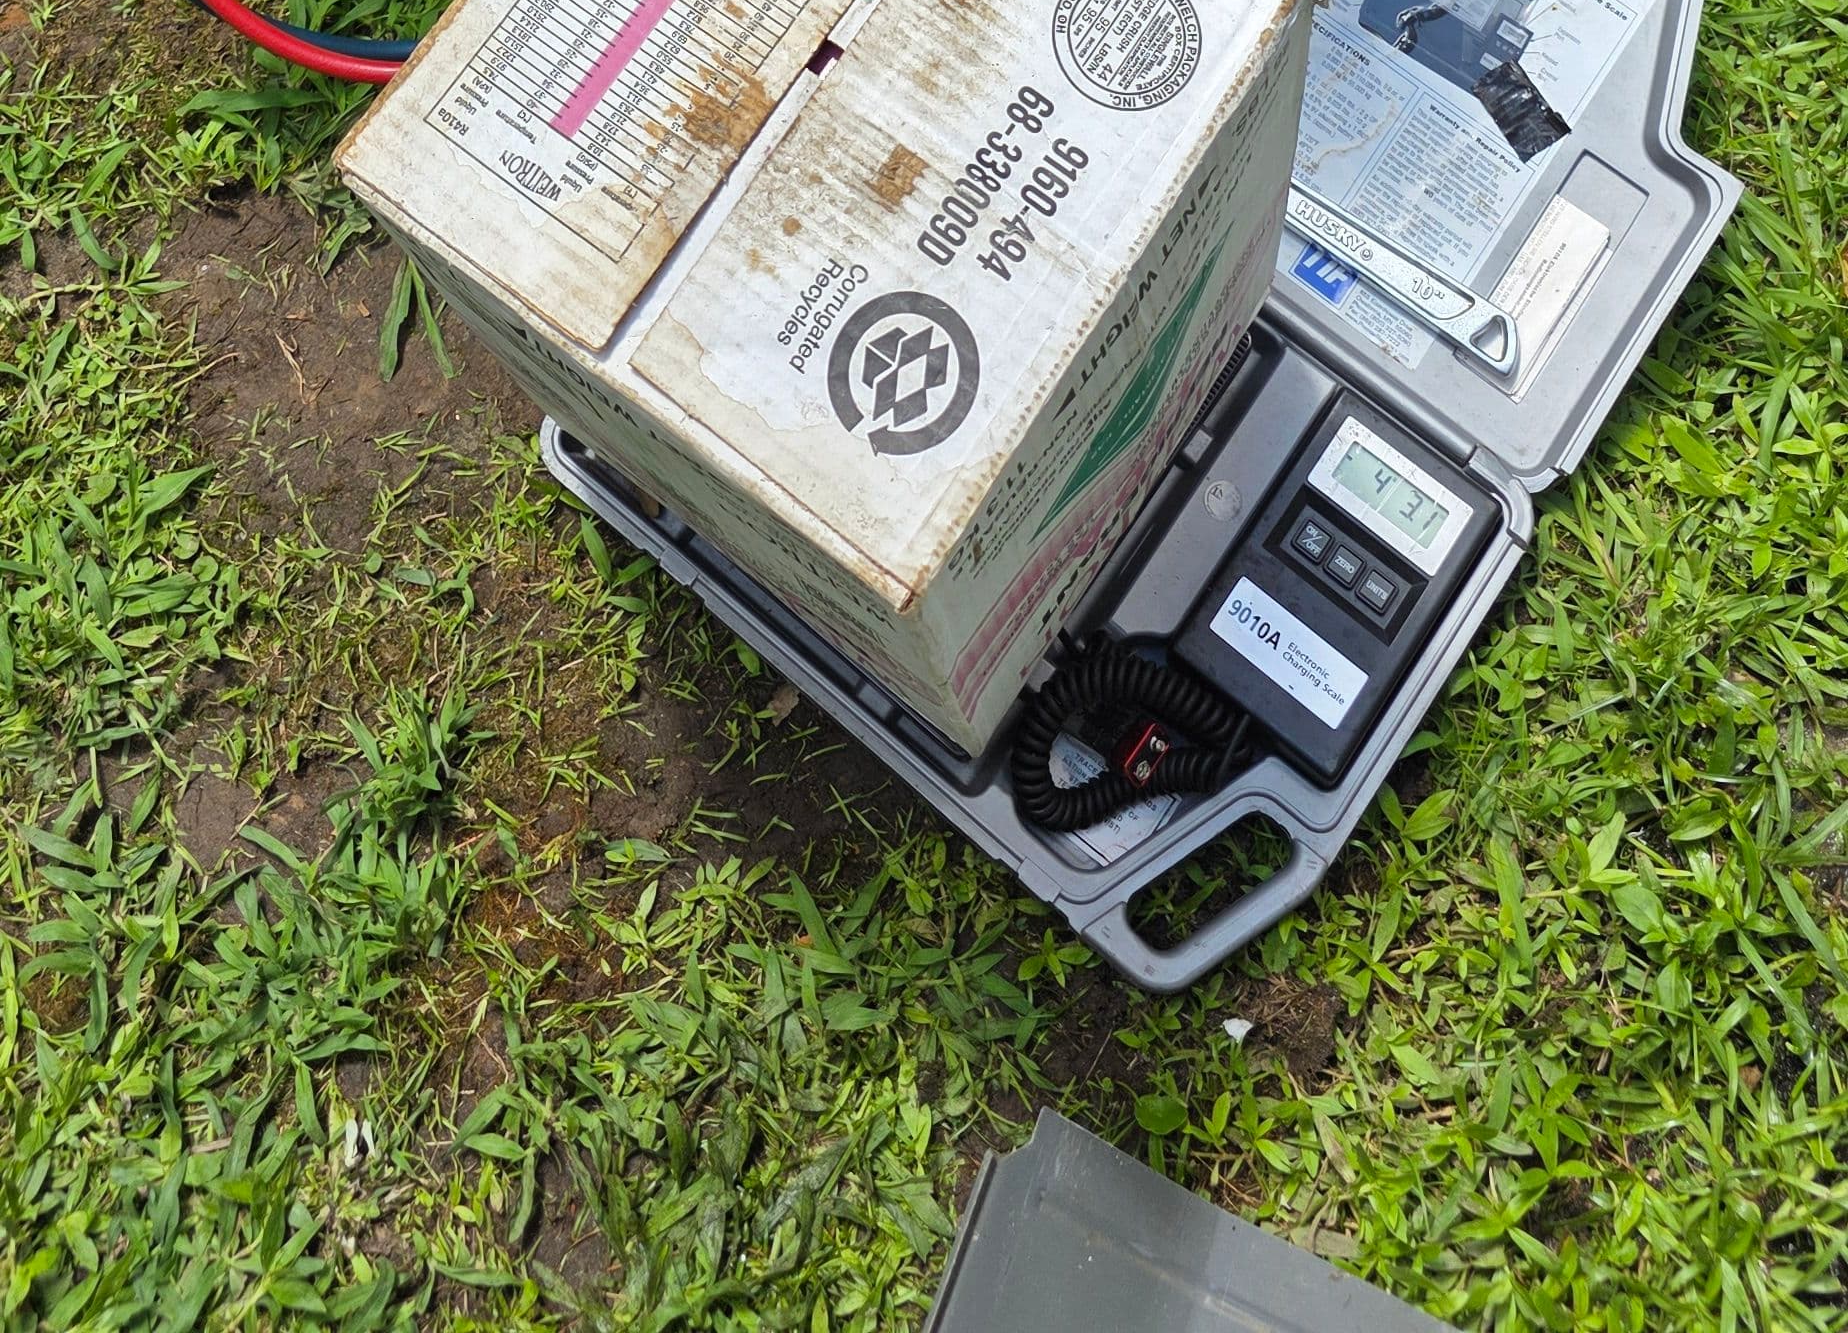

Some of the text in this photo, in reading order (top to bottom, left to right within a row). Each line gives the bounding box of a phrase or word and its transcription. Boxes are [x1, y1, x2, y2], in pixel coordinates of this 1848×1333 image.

[593, 6, 610, 21] -15
[1055, 15, 1066, 33] OH
[1080, 6, 1097, 24] 95
[1093, 15, 1110, 33] 95
[1110, 8, 1134, 37] (ECT)
[1603, 1, 1628, 22] Scale
[579, 27, 594, 41] -21
[662, 38, 682, 55] 62.2
[1077, 36, 1095, 58] INCHES
[1115, 18, 1142, 53] CRUSH
[1312, 20, 1371, 66] ECIFICATIONS
[517, 14, 643, 106] 31.1 214.4
[654, 48, 674, 66] 55.0
[722, 49, 736, 62] 20
[1086, 41, 1112, 74] LBS/IN
[1095, 61, 1115, 82] 44
[1135, 49, 1180, 90] CERTIFICATE
[1136, 31, 1174, 81] SINGLEWALL
[1138, 45, 1196, 105] PACKAGING,
[470, 74, 493, 94] (kPA)
[502, 34, 628, 126] 21.9 -32 151.0
[640, 69, 659, 86] 42.1
[487, 55, 612, 147] 14.2 -37 97.9
[1109, 93, 1136, 107] INC.
[435, 106, 471, 136] R410a
[458, 81, 595, 185] Pressure Temperature Pressure
[1427, 103, 1521, 174] Warranty Repair Policy
[453, 94, 583, 193] Liquid Liquid
[575, 149, 599, 171] (PSIG)
[492, 143, 567, 206] WEITRON
[912, 78, 1058, 272] 68-338009D
[973, 132, 1090, 285] 9160-494
[1161, 191, 1197, 270] NET
[775, 257, 844, 345] Recycles
[788, 264, 867, 374] Corrugated
[1080, 277, 1156, 392] WEIGHT
[1332, 554, 1356, 575] ZERO
[1364, 579, 1389, 601] UNITS
[1224, 598, 1287, 651] 9010A
[1280, 649, 1346, 705] Charging Scale
[1286, 641, 1331, 680] Electronic
